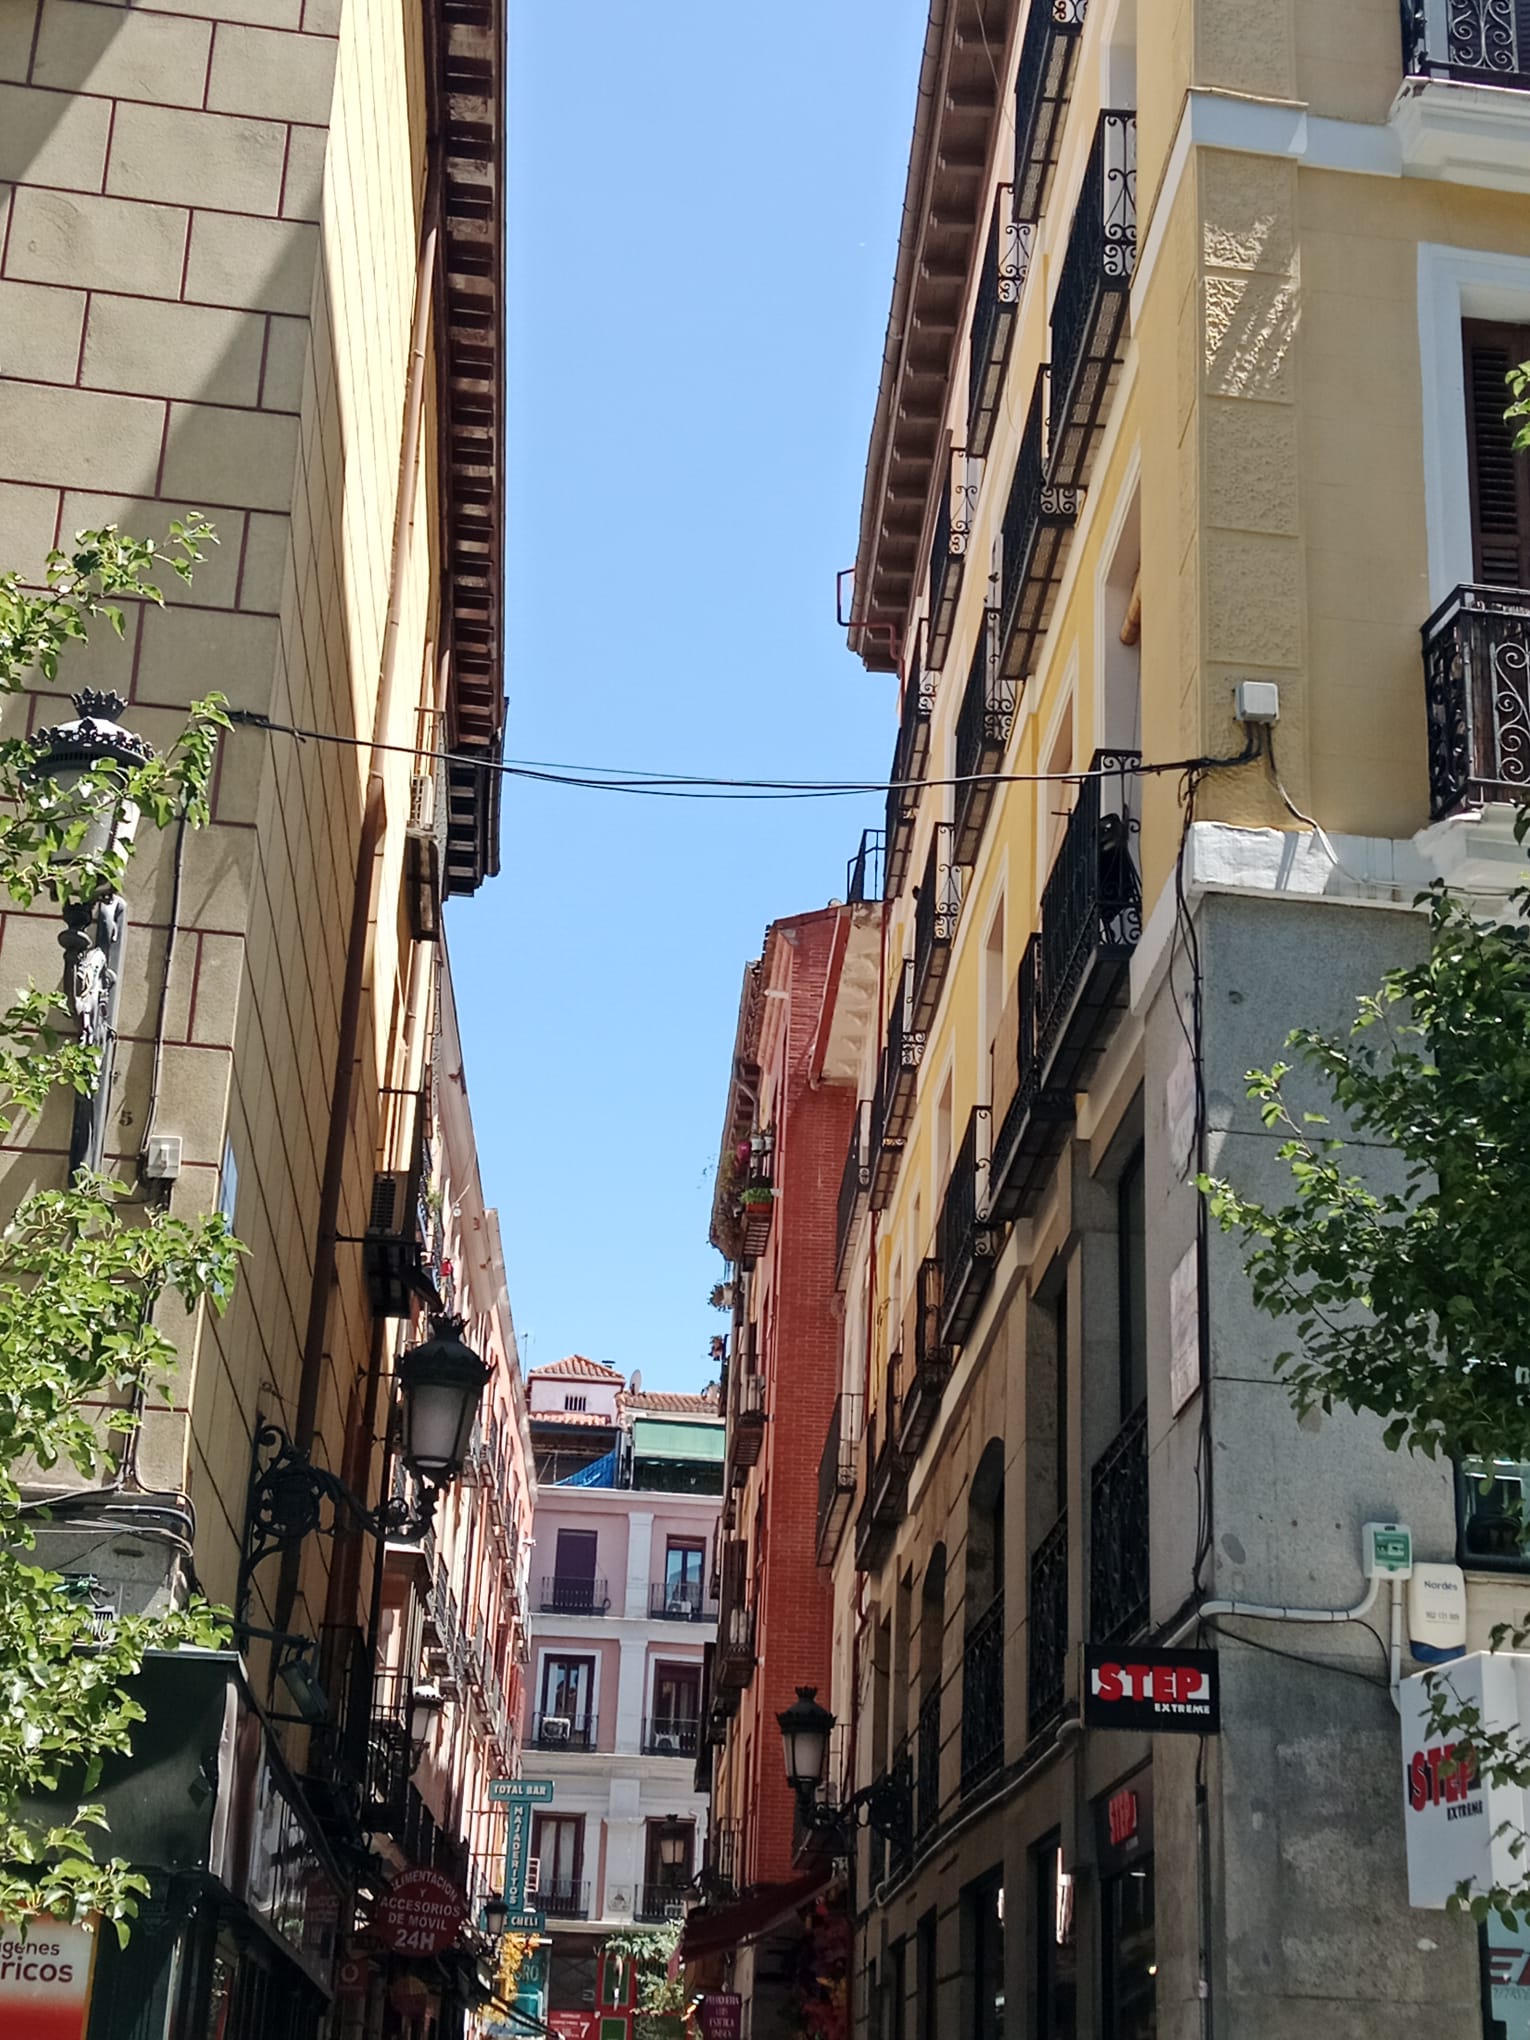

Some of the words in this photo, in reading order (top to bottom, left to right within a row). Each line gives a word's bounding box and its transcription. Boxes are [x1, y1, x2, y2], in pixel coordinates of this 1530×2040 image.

[118, 1110, 133, 1126] 5
[1098, 1662, 1203, 1703] STEP
[1154, 1703, 1210, 1714] EXTREME
[493, 1784, 523, 1795] TOTAL
[526, 1785, 546, 1795] BAR
[1447, 1800, 1483, 1821] EXTREME
[508, 1806, 524, 1905] MAJADERITOS
[420, 1888, 427, 1898] Y
[380, 1896, 461, 1917] ACCESORIOS
[388, 1911, 405, 1925] DE
[511, 1916, 538, 1927] CHELI
[394, 1928, 436, 1951] 24H
[0, 1941, 60, 1959] genes
[579, 2022, 590, 2038] 7
